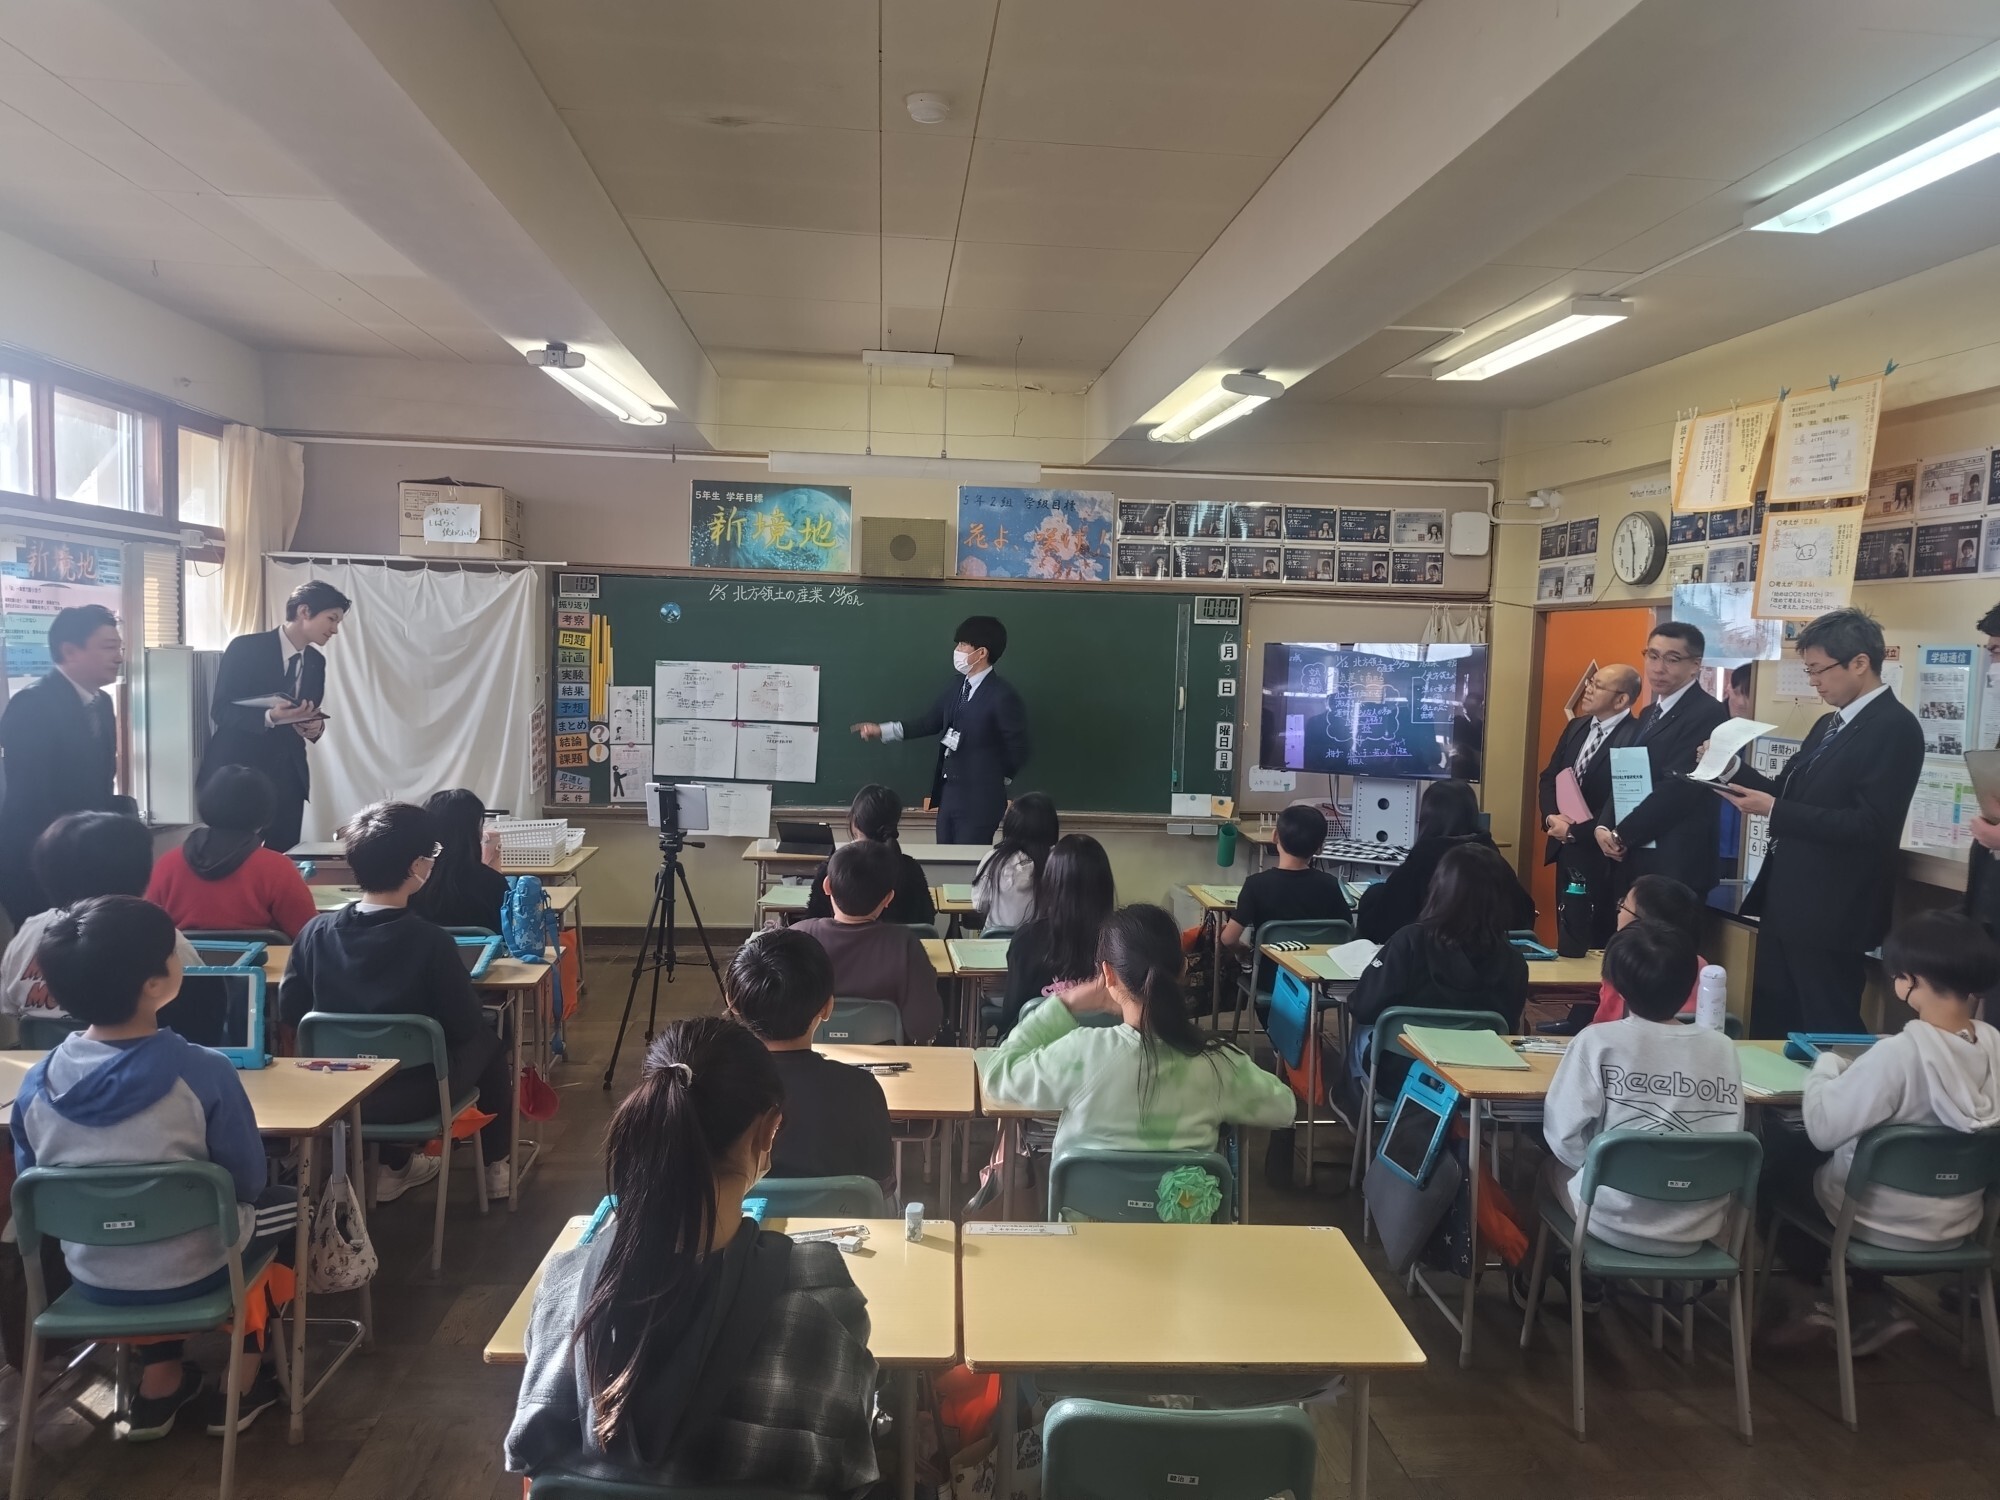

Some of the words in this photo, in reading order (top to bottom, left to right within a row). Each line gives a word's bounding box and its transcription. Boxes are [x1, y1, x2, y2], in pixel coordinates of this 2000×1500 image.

[695, 490, 721, 501] 5年生
[726, 491, 764, 503] 学年目標
[962, 494, 1013, 508] 5年2組
[1023, 497, 1076, 511] 学級目標
[706, 505, 837, 549] 新境地
[27, 541, 97, 581] 新境地
[733, 585, 825, 603] 北方領土の産業
[558, 600, 589, 610] 振り返り
[1203, 598, 1238, 618] 10:00
[562, 614, 585, 626] 考察
[561, 633, 587, 647] 問題
[561, 651, 585, 664] 計画
[1223, 646, 1235, 659] 月
[1931, 651, 1967, 664] 学級通信
[561, 669, 584, 680] 実験
[1224, 665, 1232, 675] 3
[561, 685, 585, 696] 結果
[1222, 681, 1232, 694] 日
[561, 702, 584, 714] 予想
[558, 719, 587, 731] まとめ
[560, 735, 582, 748] 結論
[1219, 725, 1231, 748] 曜日
[1771, 744, 1797, 754] 時間わり
[559, 752, 583, 765] 課題
[1219, 752, 1228, 769] 日直
[560, 773, 583, 785] 見通し
[1753, 825, 1758, 836] 5
[1751, 842, 1756, 852] 6
[1600, 1064, 1738, 1105] Reebok
